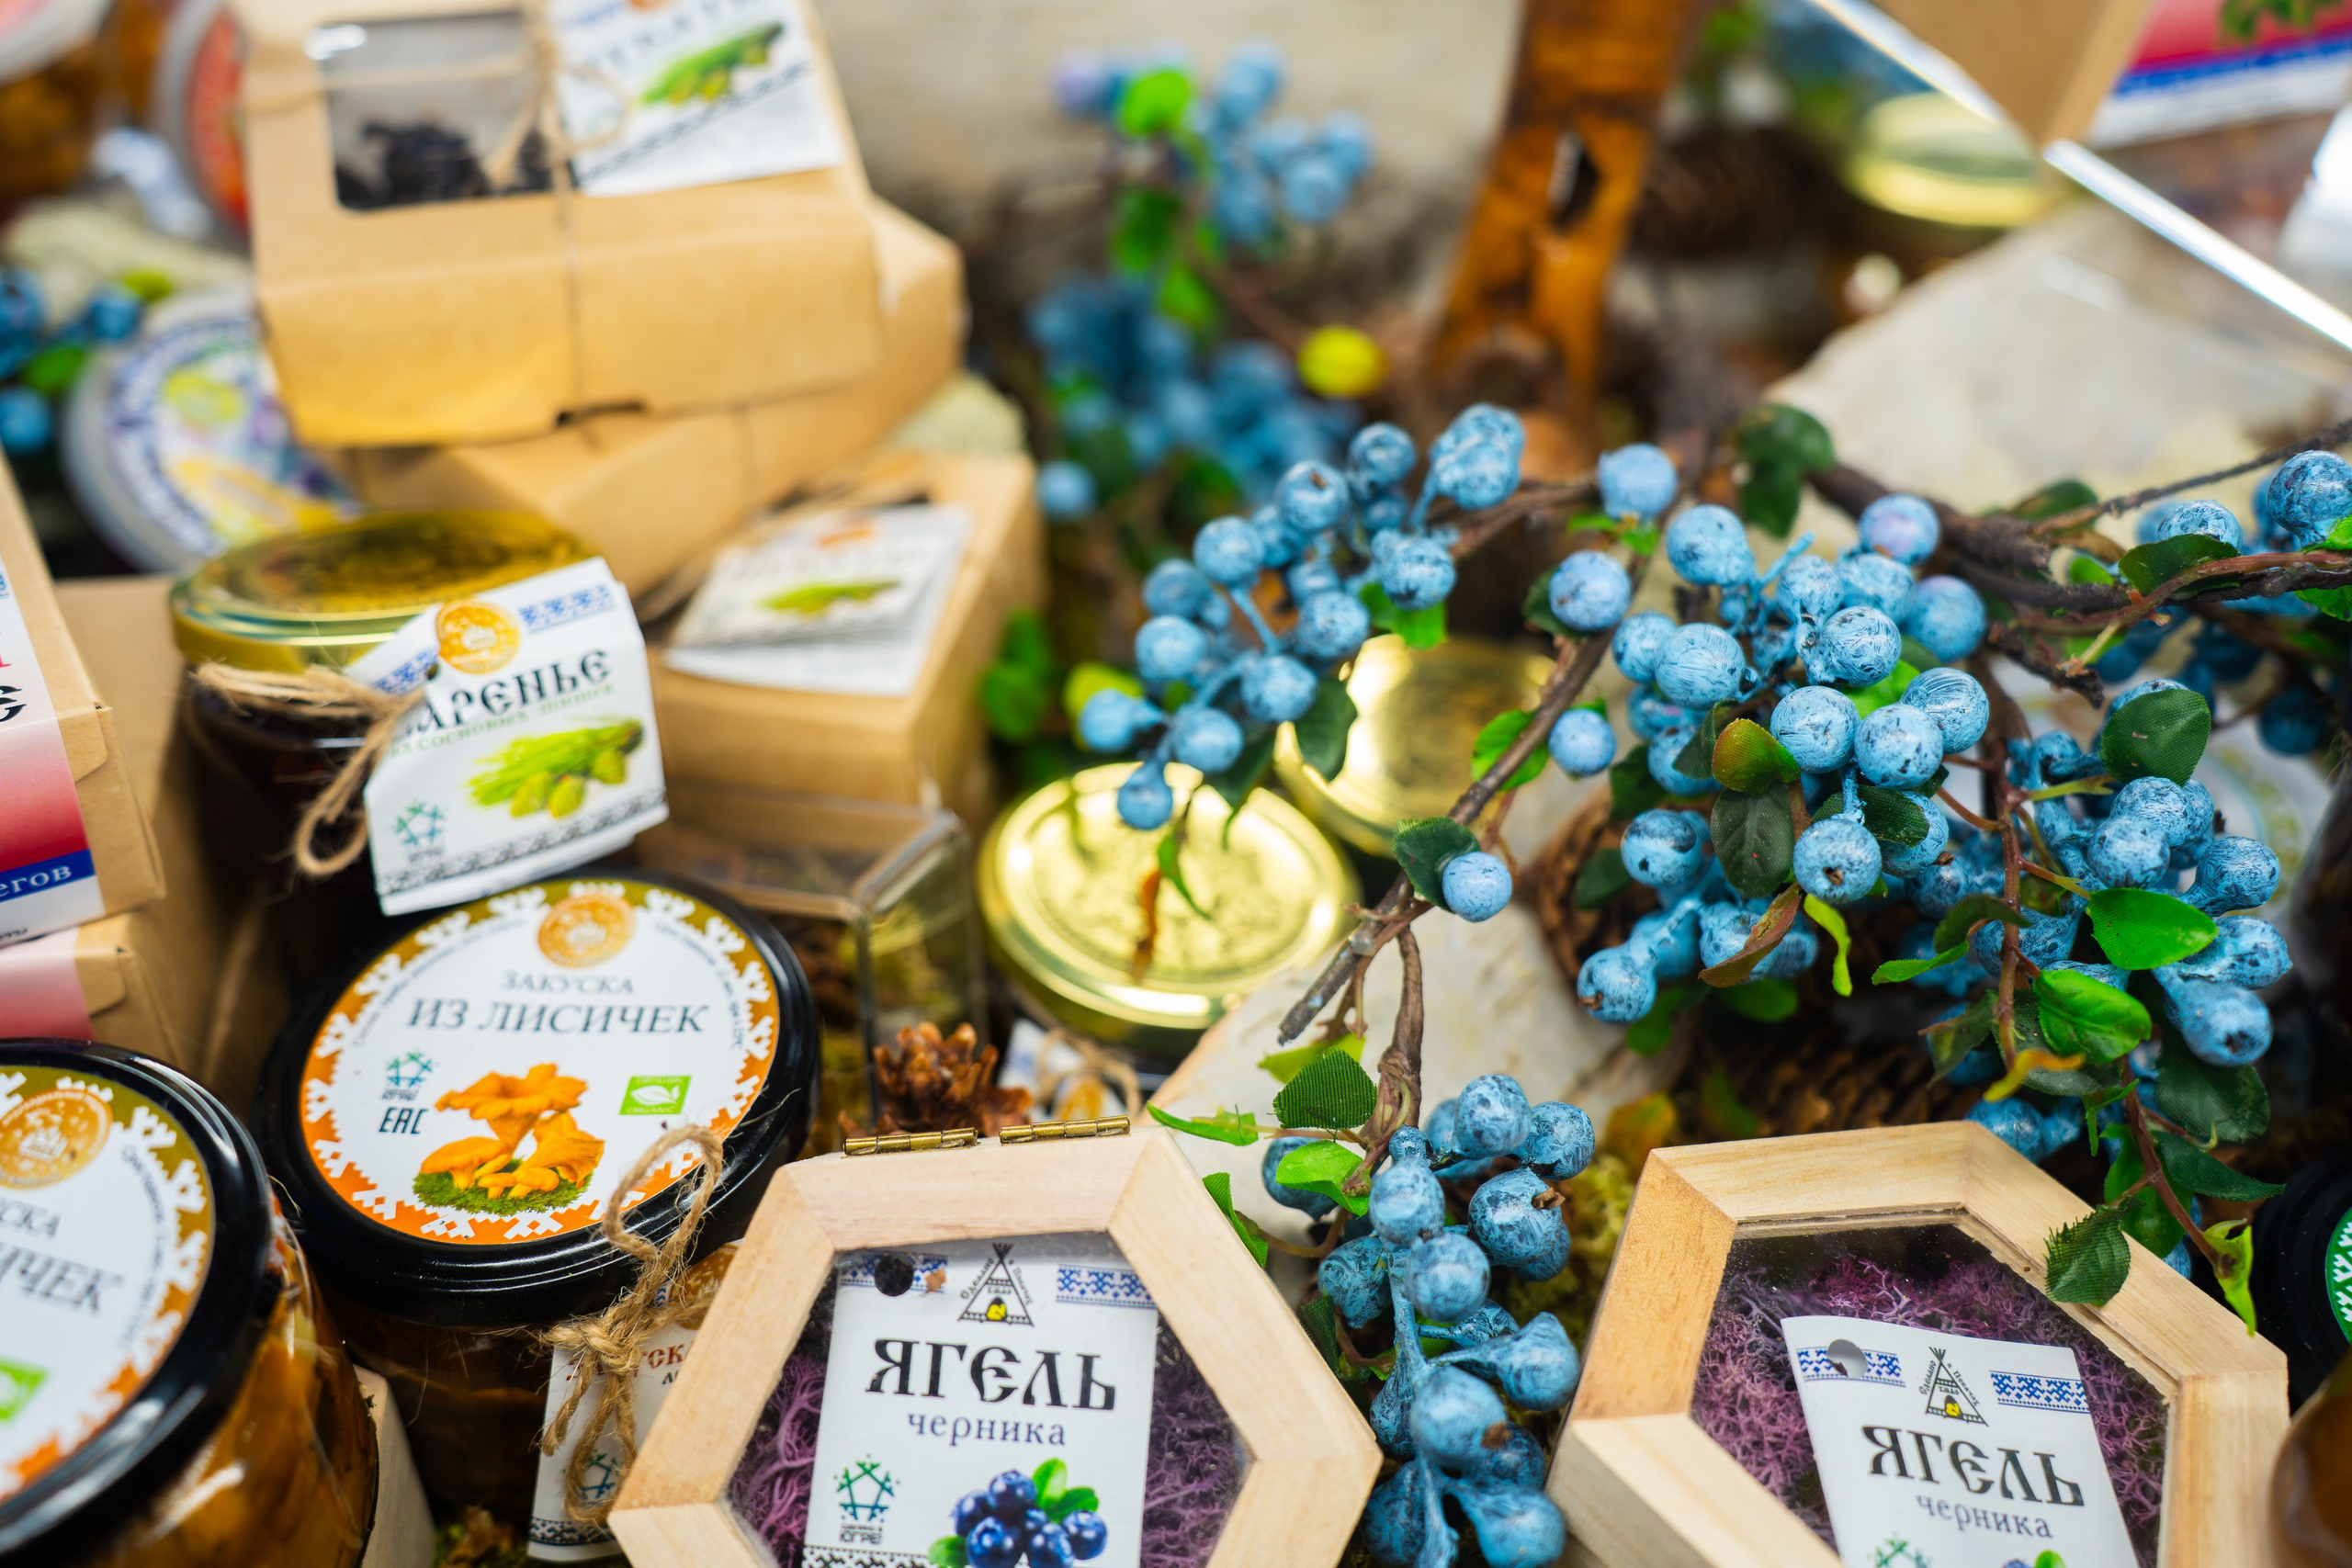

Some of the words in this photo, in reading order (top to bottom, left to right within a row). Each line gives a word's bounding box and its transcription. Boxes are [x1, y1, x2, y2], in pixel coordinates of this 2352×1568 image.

[409, 649, 611, 736] АРЕНЬЕ
[503, 970, 635, 995] ЗАКУСКА
[408, 998, 469, 1030] ИЗ
[478, 1000, 710, 1034] ЛИСИЧЕК
[379, 1106, 429, 1135] EAC
[865, 1337, 1116, 1411] ЯГЕЛЬ
[907, 1412, 1067, 1447] черника
[1860, 1425, 2085, 1507] ЯГЕЛЬ
[1916, 1494, 2053, 1540] черника
